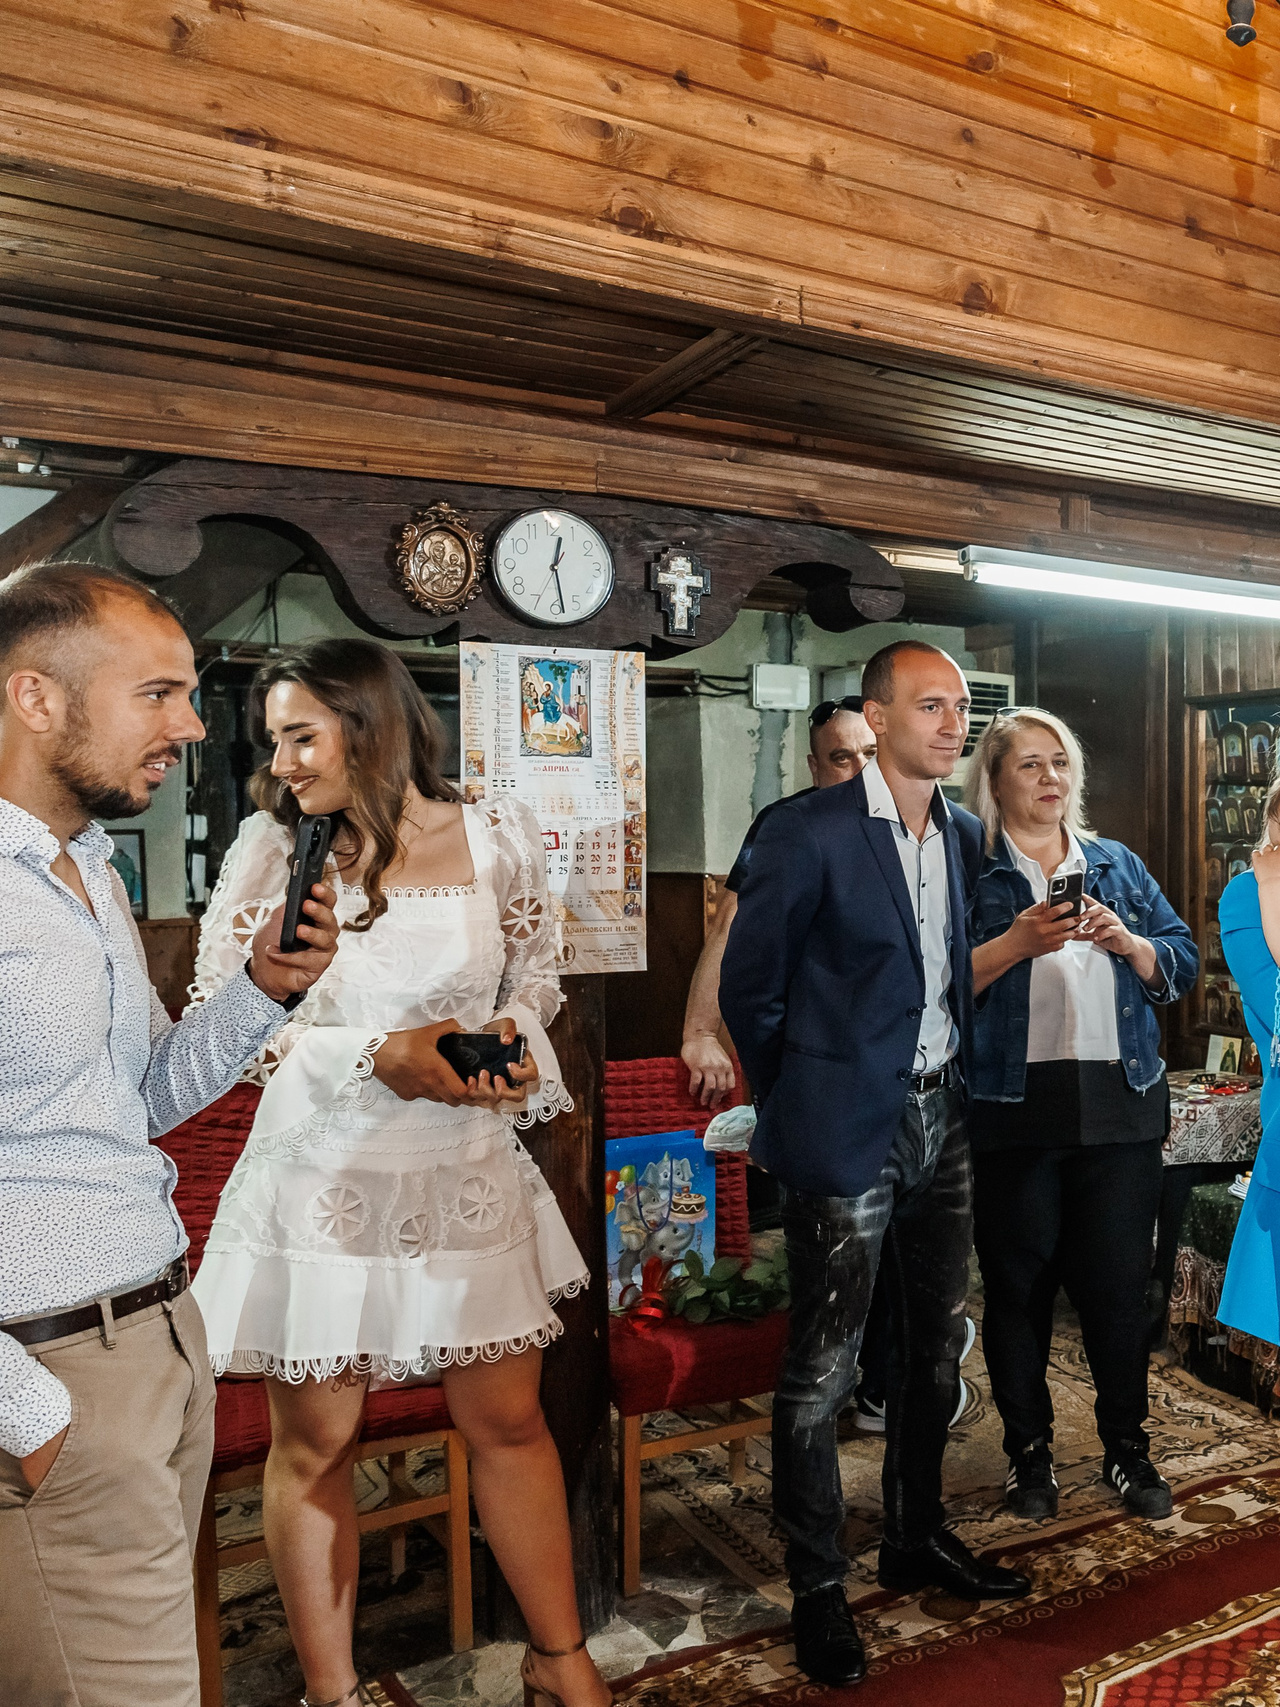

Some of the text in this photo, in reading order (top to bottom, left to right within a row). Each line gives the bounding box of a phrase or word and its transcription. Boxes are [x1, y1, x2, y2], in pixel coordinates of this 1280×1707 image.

[526, 523, 537, 540] 11
[570, 526, 575, 542] 1
[511, 537, 528, 555] 10
[582, 540, 593, 557] 2
[503, 557, 516, 575] 9
[592, 561, 602, 579] 3
[512, 575, 525, 595] 8
[530, 593, 541, 611] 7
[549, 598, 562, 616] 6
[571, 594, 581, 612] 5
[562, 829, 568, 837] 4
[579, 829, 585, 837] 5
[594, 829, 601, 837] 6
[610, 829, 617, 838] 7
[561, 842, 568, 850] 11
[576, 842, 585, 850] 12
[592, 842, 601, 850] 13
[607, 842, 617, 850] 14
[559, 854, 569, 863] 18
[576, 854, 585, 863] 19
[590, 854, 601, 863] 20
[607, 854, 616, 863] 21
[558, 867, 568, 875] 25
[574, 867, 585, 875] 26
[591, 867, 601, 875] 27
[606, 867, 617, 875] 28
